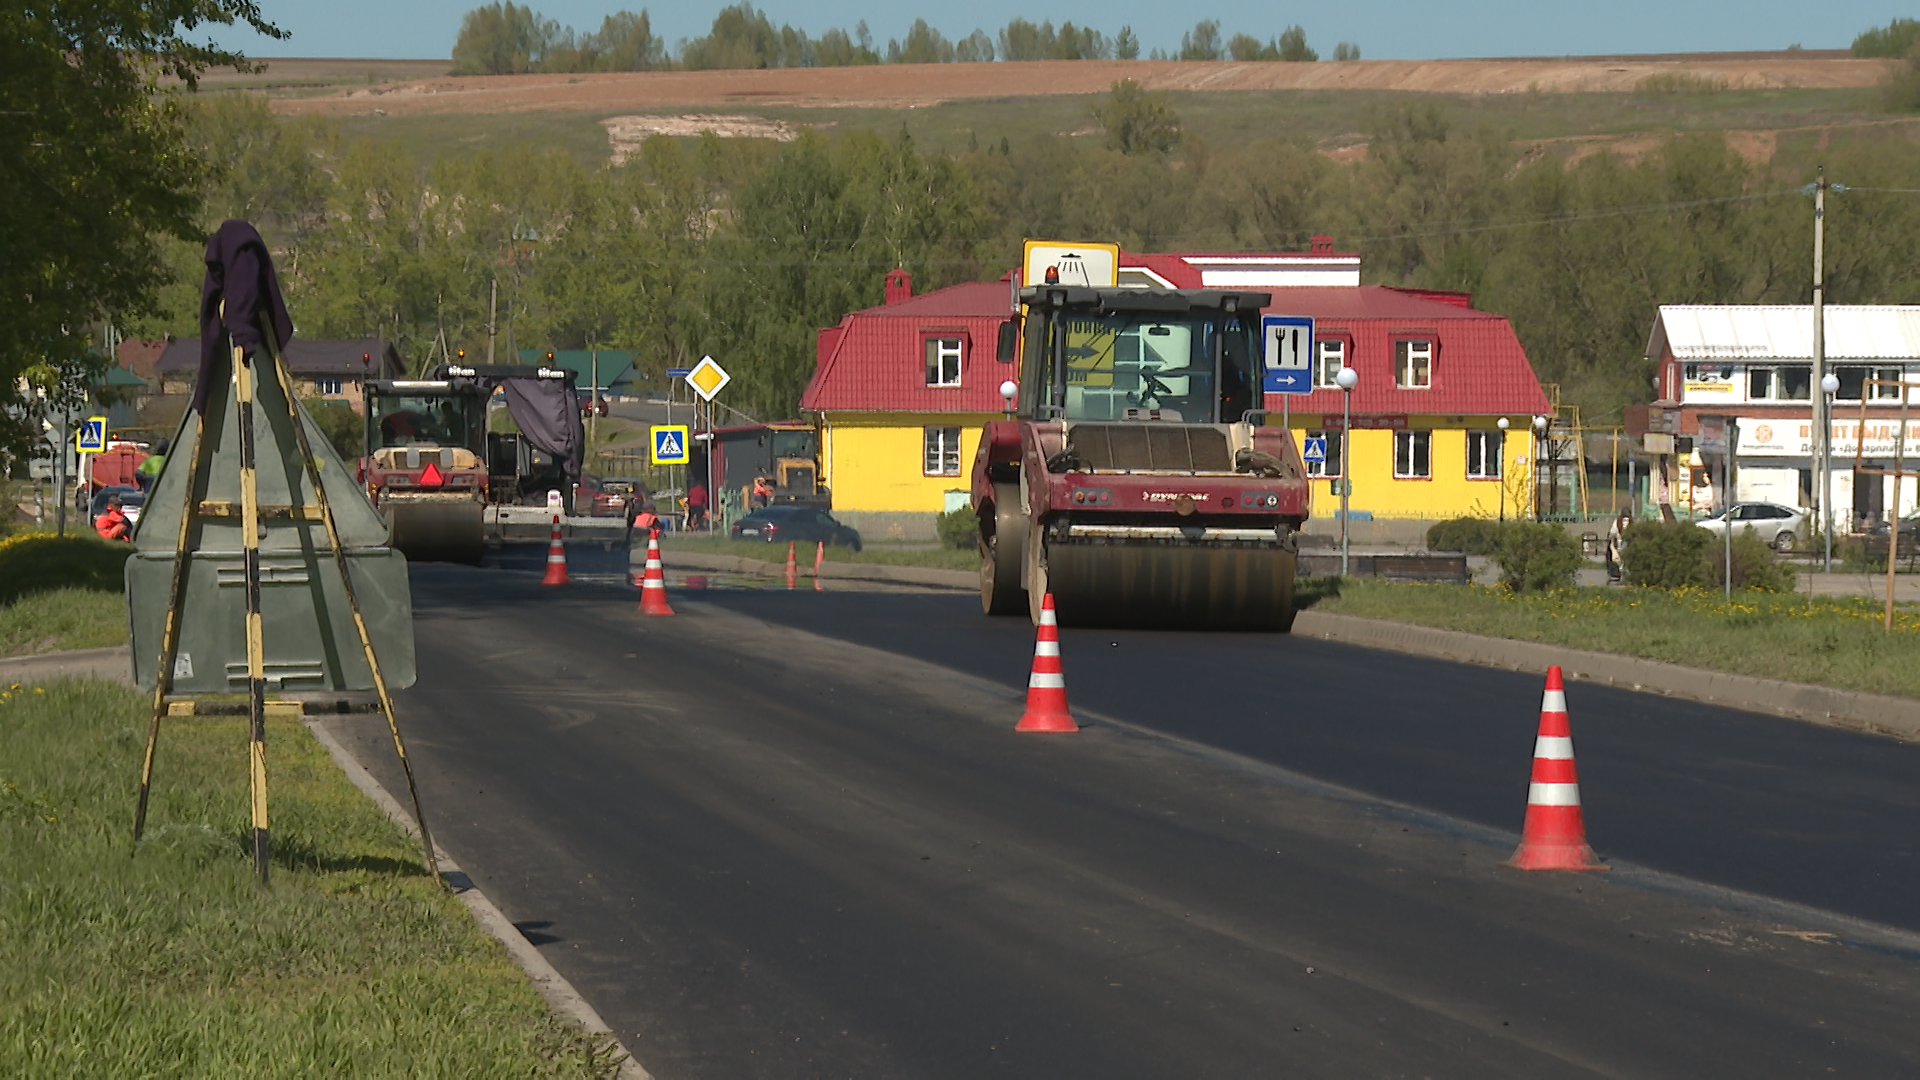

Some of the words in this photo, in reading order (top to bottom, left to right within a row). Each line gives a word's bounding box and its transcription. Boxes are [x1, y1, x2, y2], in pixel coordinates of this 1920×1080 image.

[448, 365, 475, 376] titan
[538, 367, 564, 378] titan
[1799, 425, 1848, 438] ПКТ
